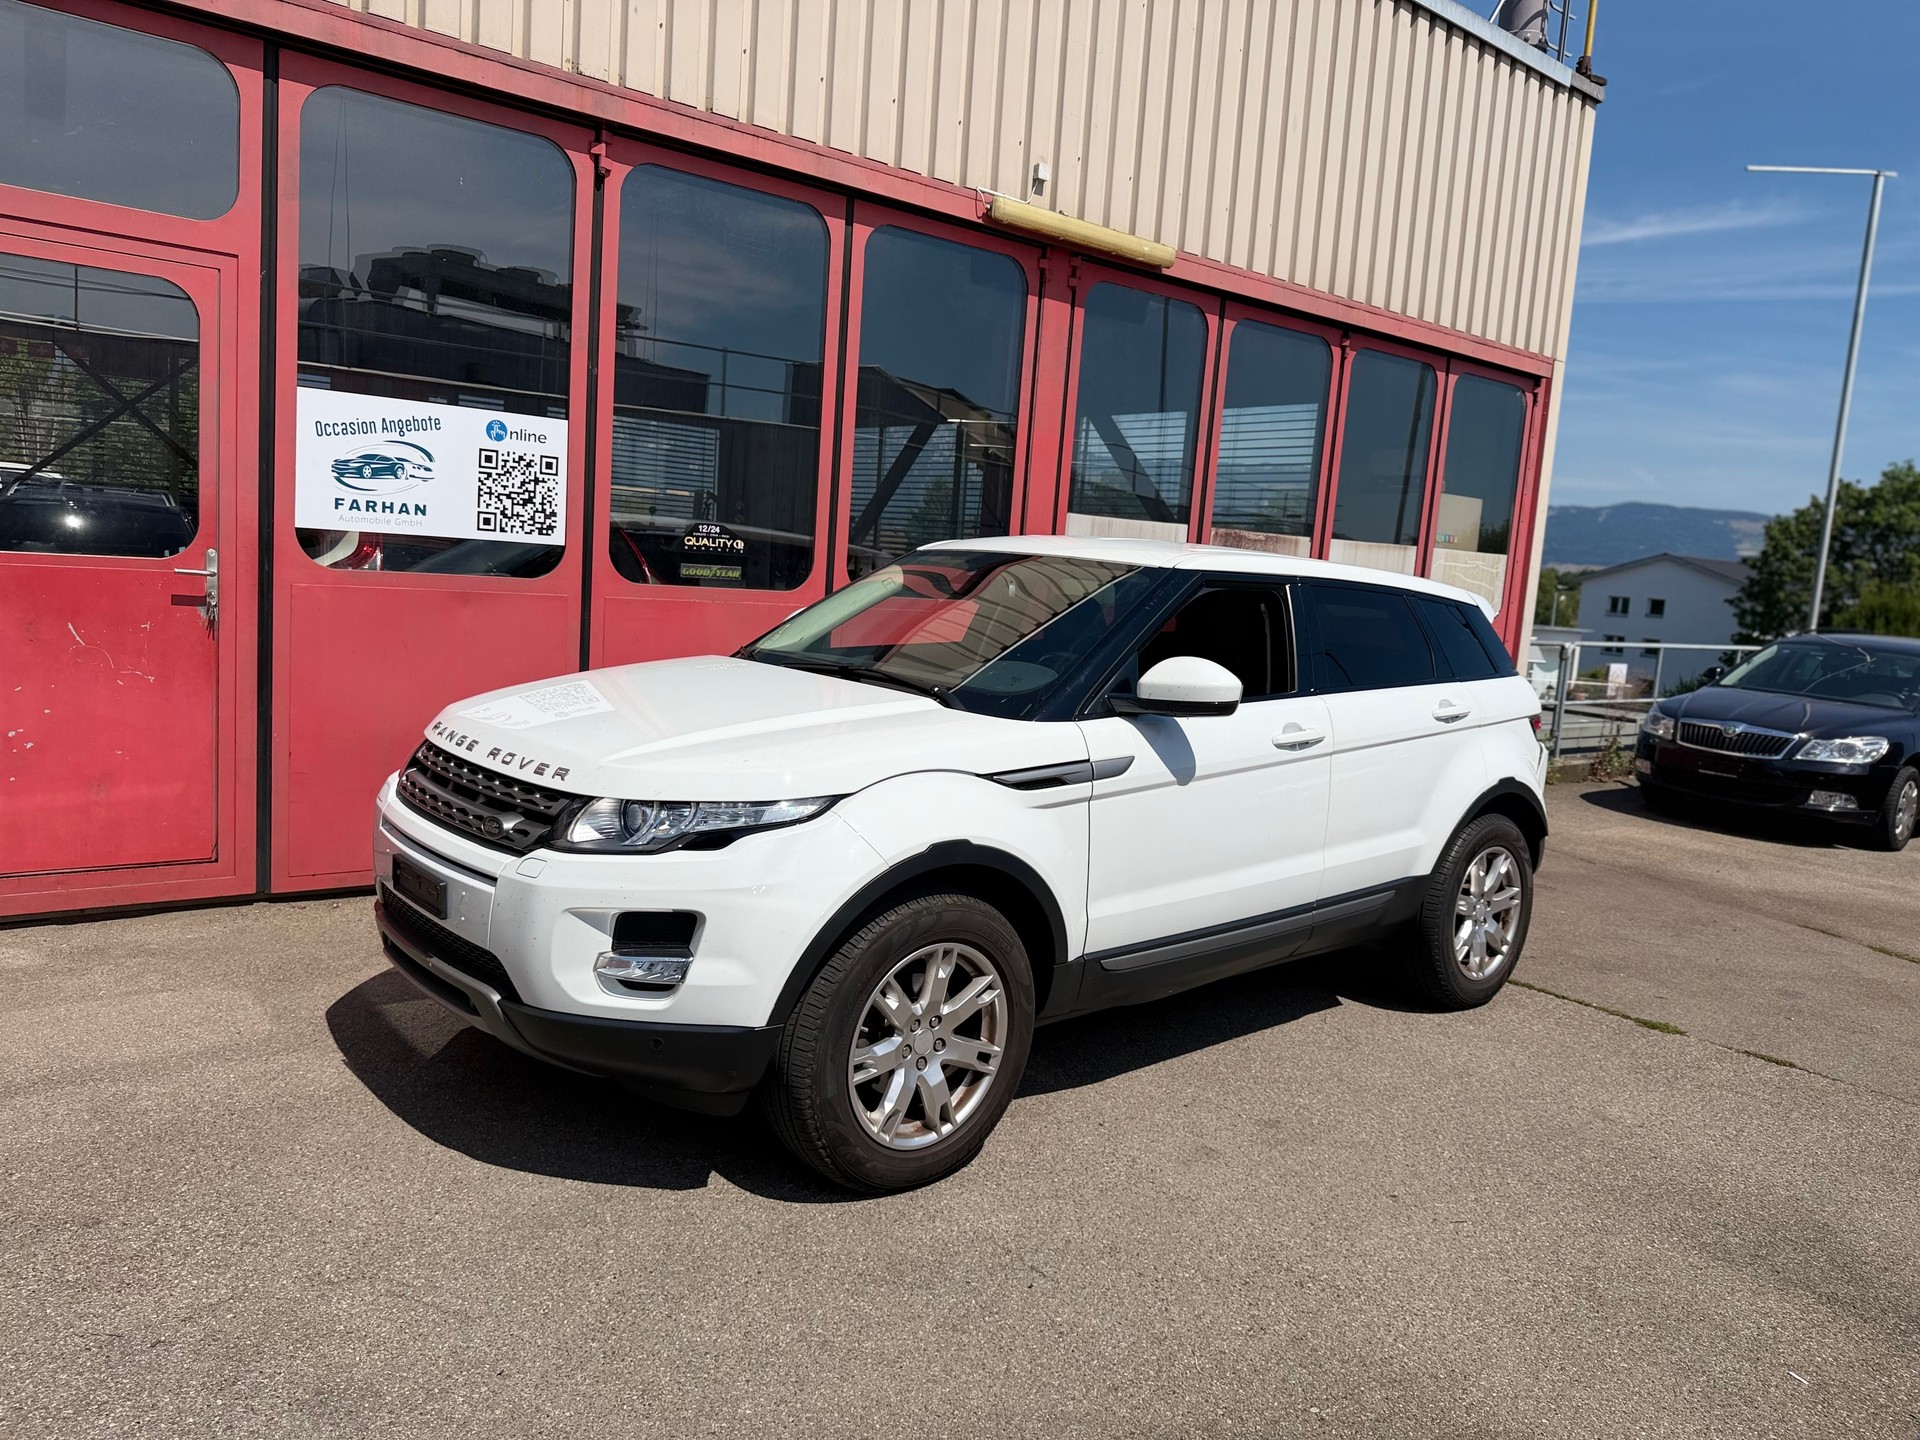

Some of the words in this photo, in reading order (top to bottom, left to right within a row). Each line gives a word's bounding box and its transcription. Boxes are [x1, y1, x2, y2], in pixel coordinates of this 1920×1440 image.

[315, 418, 377, 437] Occasion
[381, 415, 442, 437] Angebote
[334, 497, 427, 516] FARHAN
[338, 514, 391, 526] Automobile
[394, 518, 423, 527] GmbH
[698, 525, 721, 534] 12/24
[432, 720, 480, 753] RANGE
[486, 746, 571, 782] ROVER
